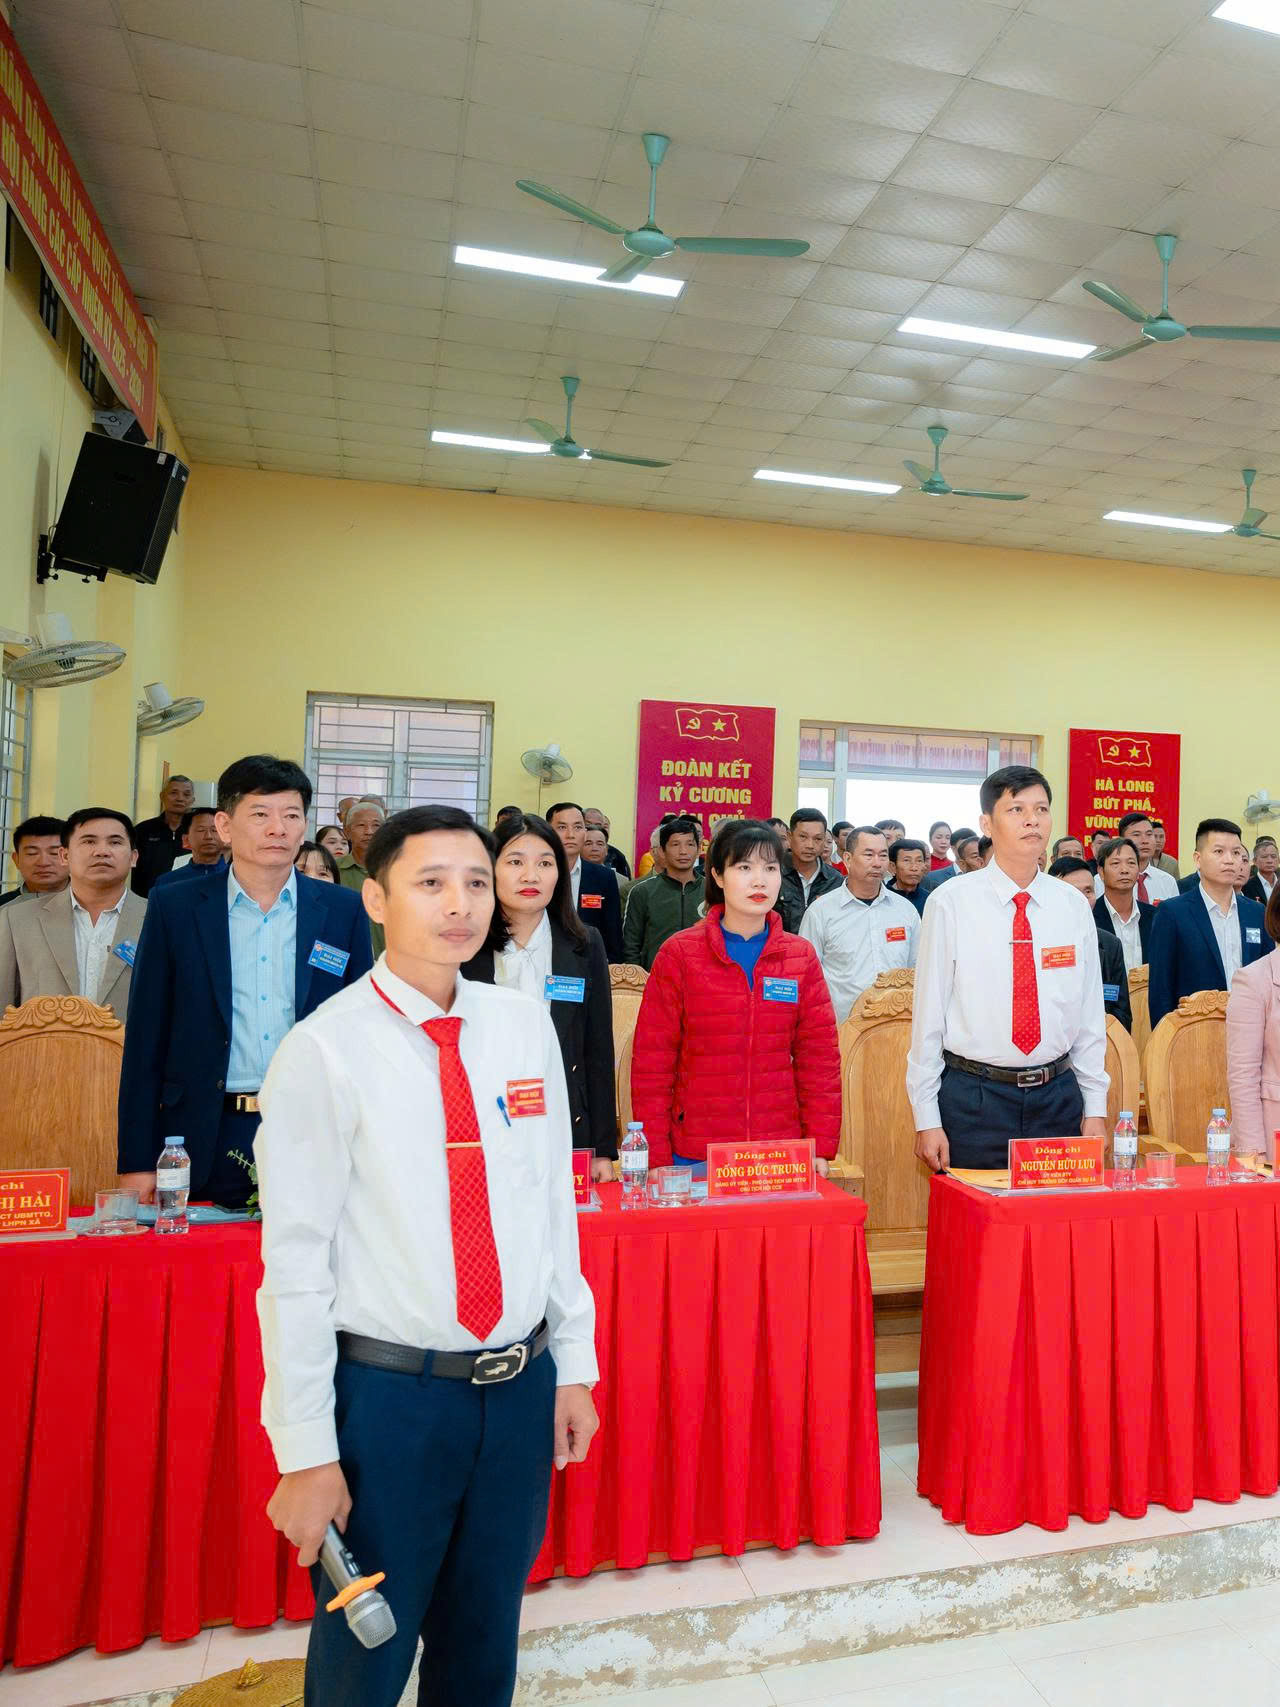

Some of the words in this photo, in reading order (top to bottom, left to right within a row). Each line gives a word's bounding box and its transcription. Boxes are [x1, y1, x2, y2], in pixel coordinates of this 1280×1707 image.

[72, 189, 91, 256] LONG
[49, 208, 65, 267] CÁC
[67, 242, 81, 294] CẤP
[661, 758, 713, 777] ĐOÀN
[718, 758, 752, 779] KẾT
[659, 781, 684, 802] KỶ
[689, 786, 752, 805] CƯƠNG
[1095, 777, 1114, 792] HÀ
[1118, 780, 1155, 793] LONG
[1093, 796, 1120, 810] BỨT
[1123, 797, 1156, 813] PHÁ,
[734, 1151, 765, 1160] Đồng
[768, 1150, 786, 1158] chí
[1020, 1156, 1056, 1171] NGUYỄN
[716, 1163, 744, 1178] TỐNG
[747, 1163, 768, 1176] ĐỨC
[771, 1163, 806, 1175] TRUNG
[1, 1181, 24, 1190] chí
[20, 1191, 51, 1209] HẢI
